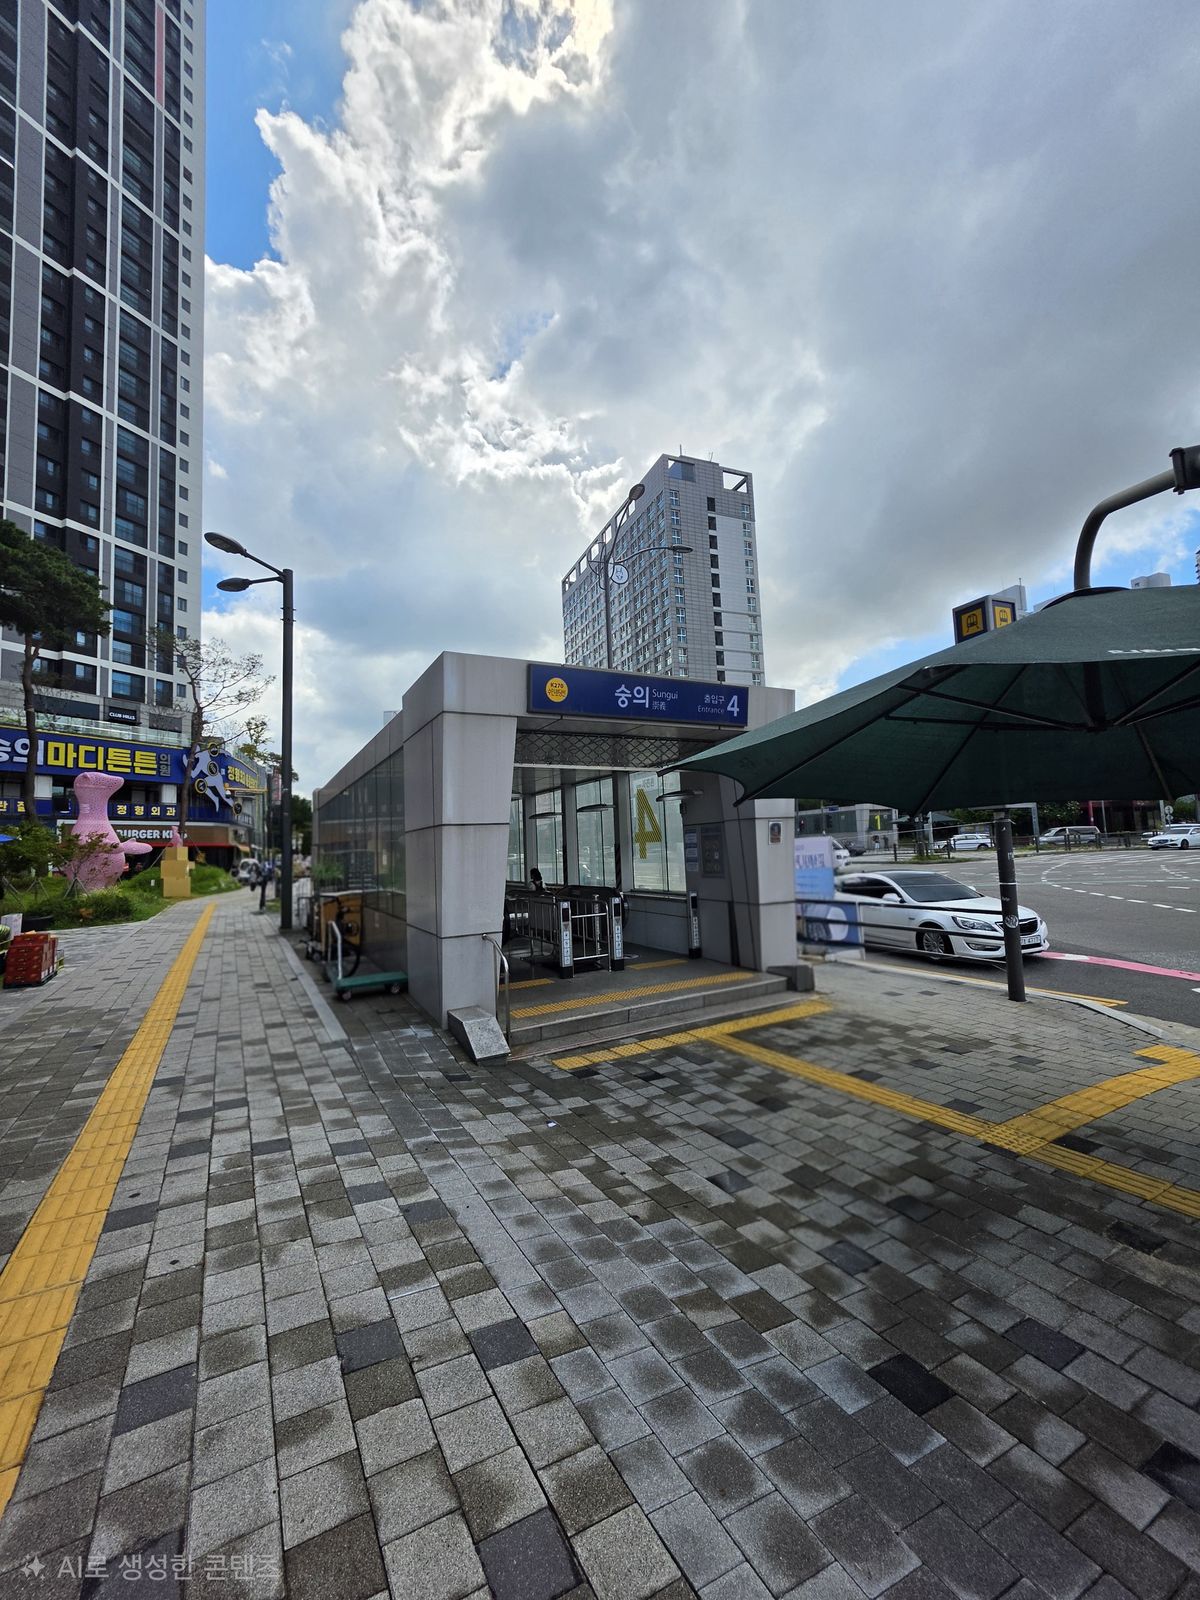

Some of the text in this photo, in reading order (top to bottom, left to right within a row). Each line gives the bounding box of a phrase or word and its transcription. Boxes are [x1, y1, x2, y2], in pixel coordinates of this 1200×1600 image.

[614, 684, 649, 708] 숭의
[652, 688, 678, 700] Sungui
[704, 694, 725, 704] 출입구
[697, 705, 725, 714] Entrance
[727, 695, 740, 717] 4
